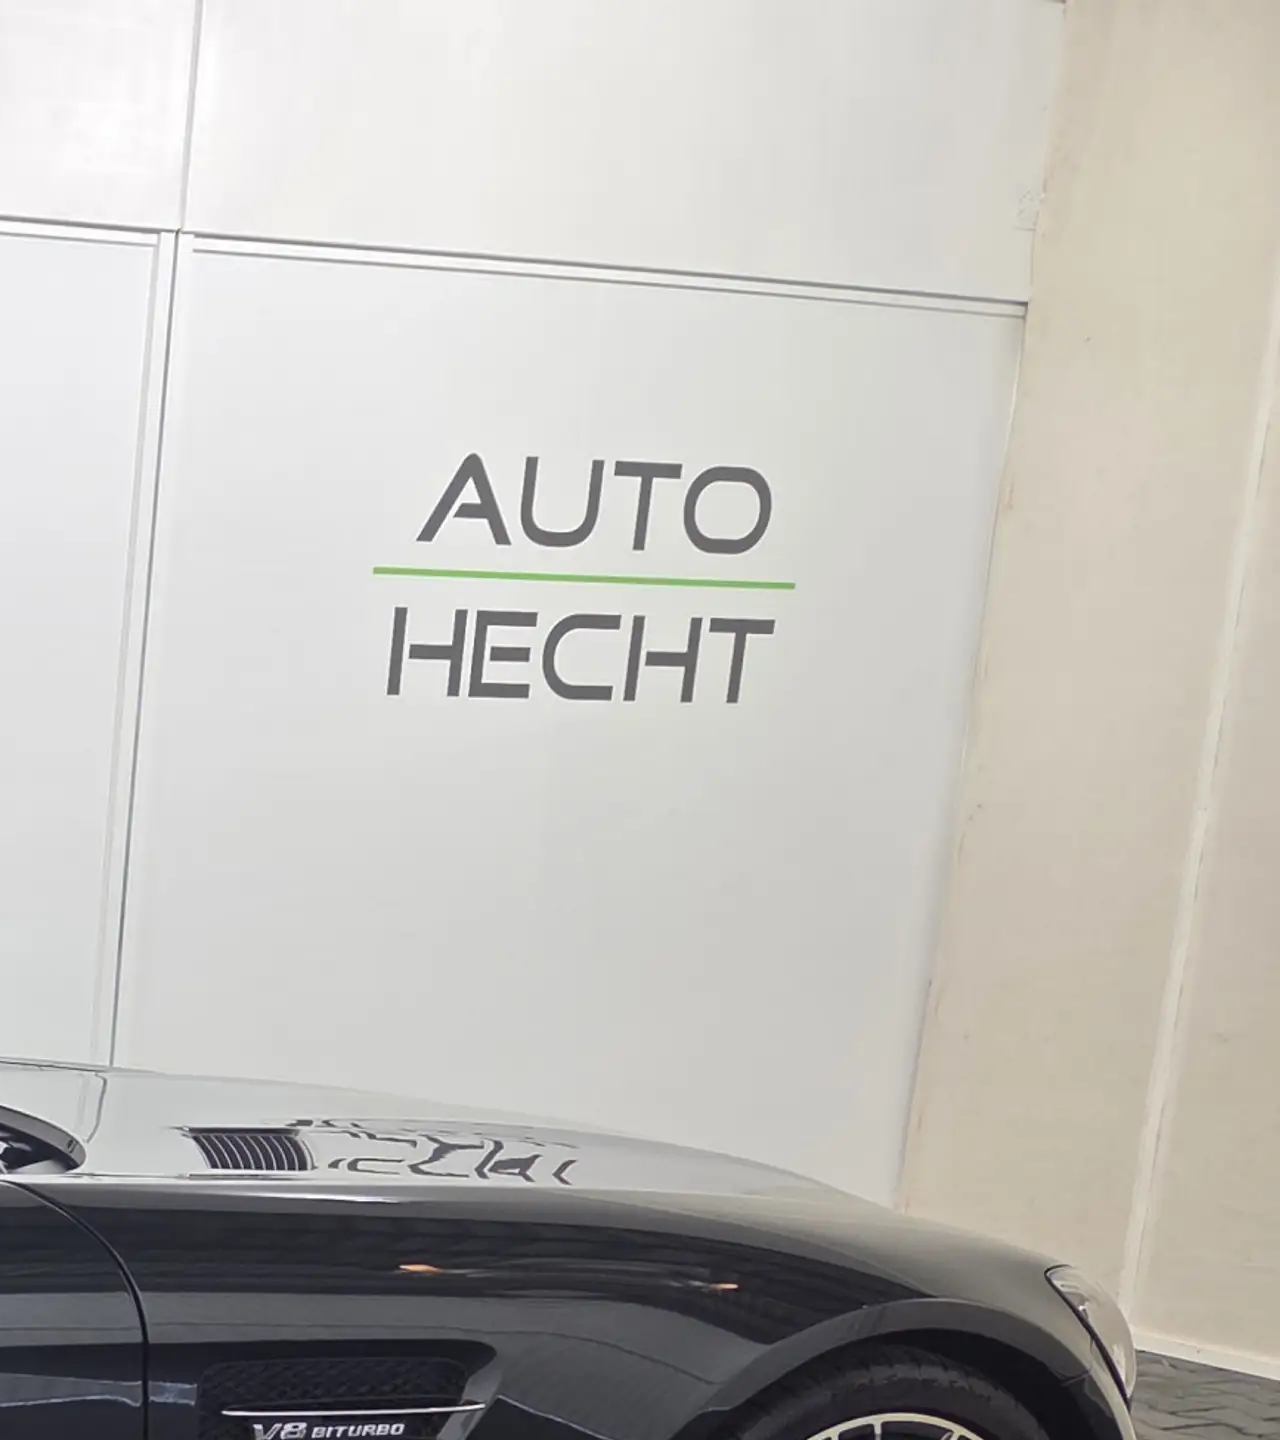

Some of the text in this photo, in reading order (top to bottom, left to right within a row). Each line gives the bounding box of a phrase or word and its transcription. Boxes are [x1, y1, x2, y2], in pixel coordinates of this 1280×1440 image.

[417, 454, 771, 554] AUTO
[387, 607, 775, 703] HECHT
[252, 1422, 405, 1440] V8 BITURBO
